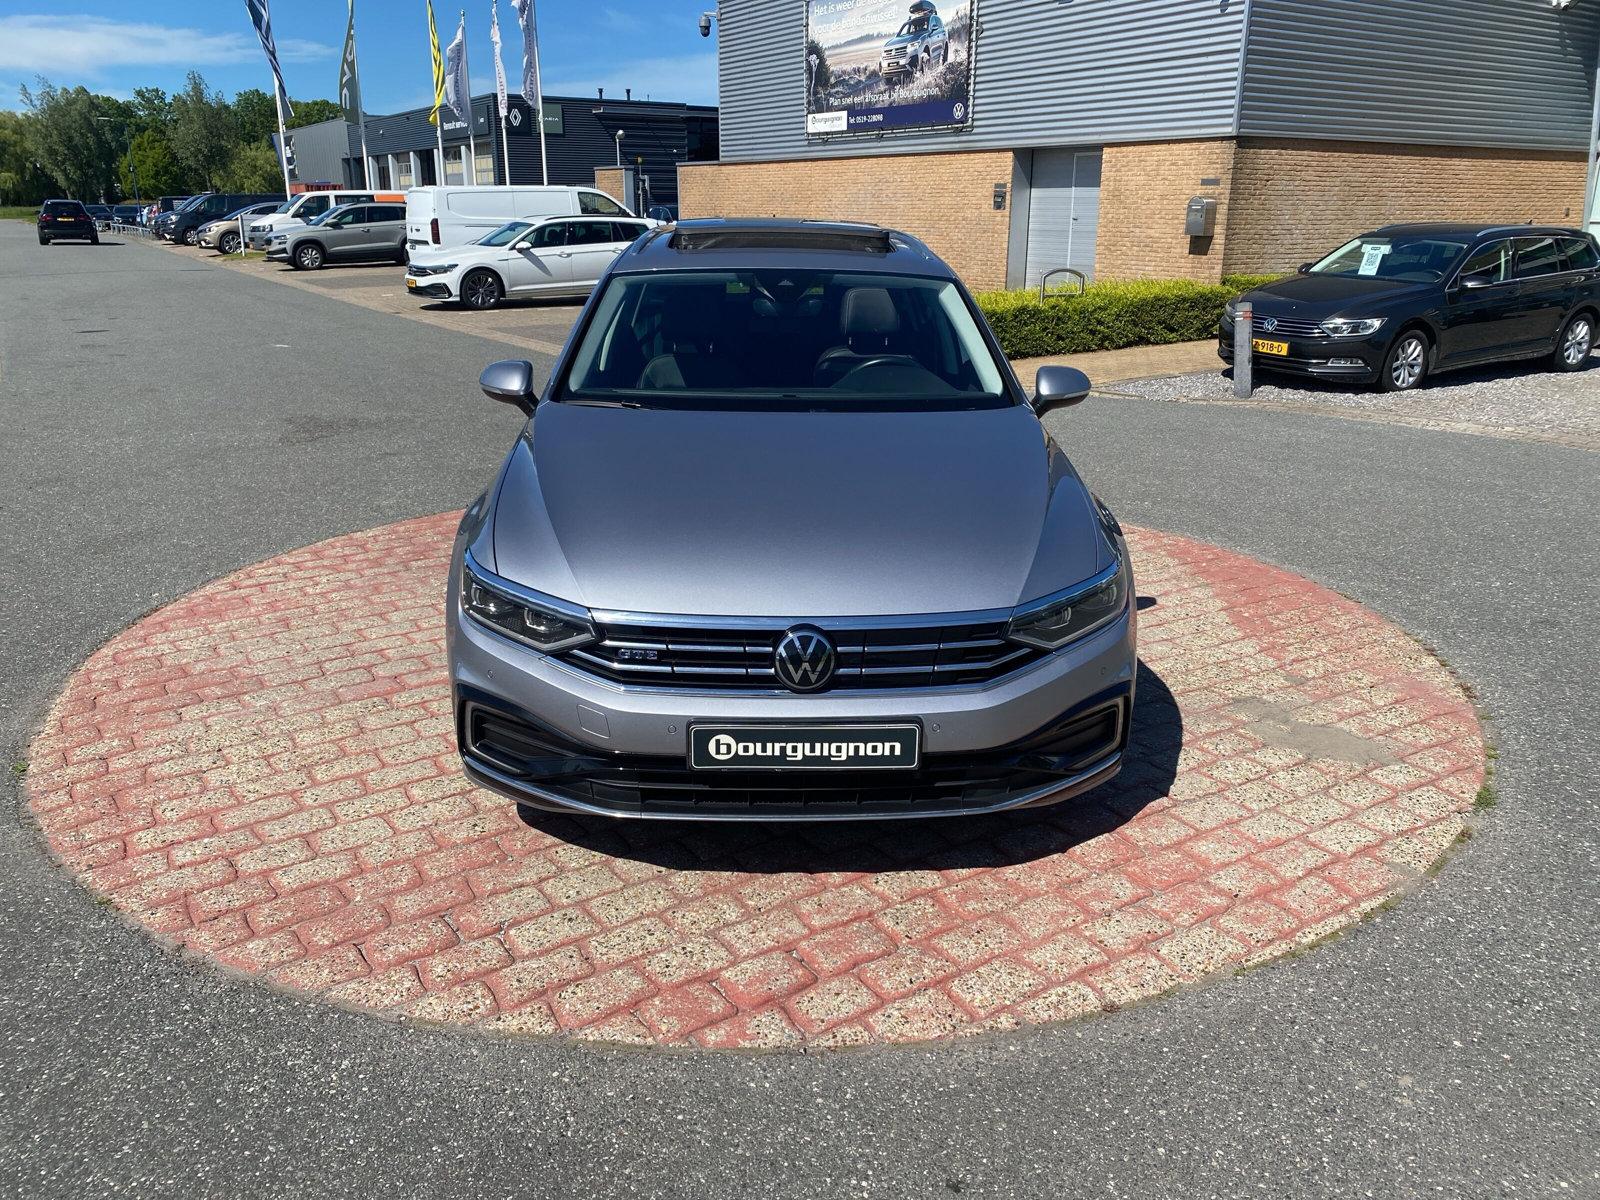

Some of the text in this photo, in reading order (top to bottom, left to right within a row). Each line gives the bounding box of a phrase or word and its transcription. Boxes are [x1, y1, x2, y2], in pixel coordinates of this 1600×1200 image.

[814, 5, 828, 16] Het
[828, 2, 835, 13] is
[836, 0, 855, 11] weer
[829, 97, 841, 106] Plan
[841, 95, 853, 105] snel
[864, 92, 889, 104] afspraak
[618, 649, 658, 660] GTE
[708, 733, 901, 761] bourguignon
